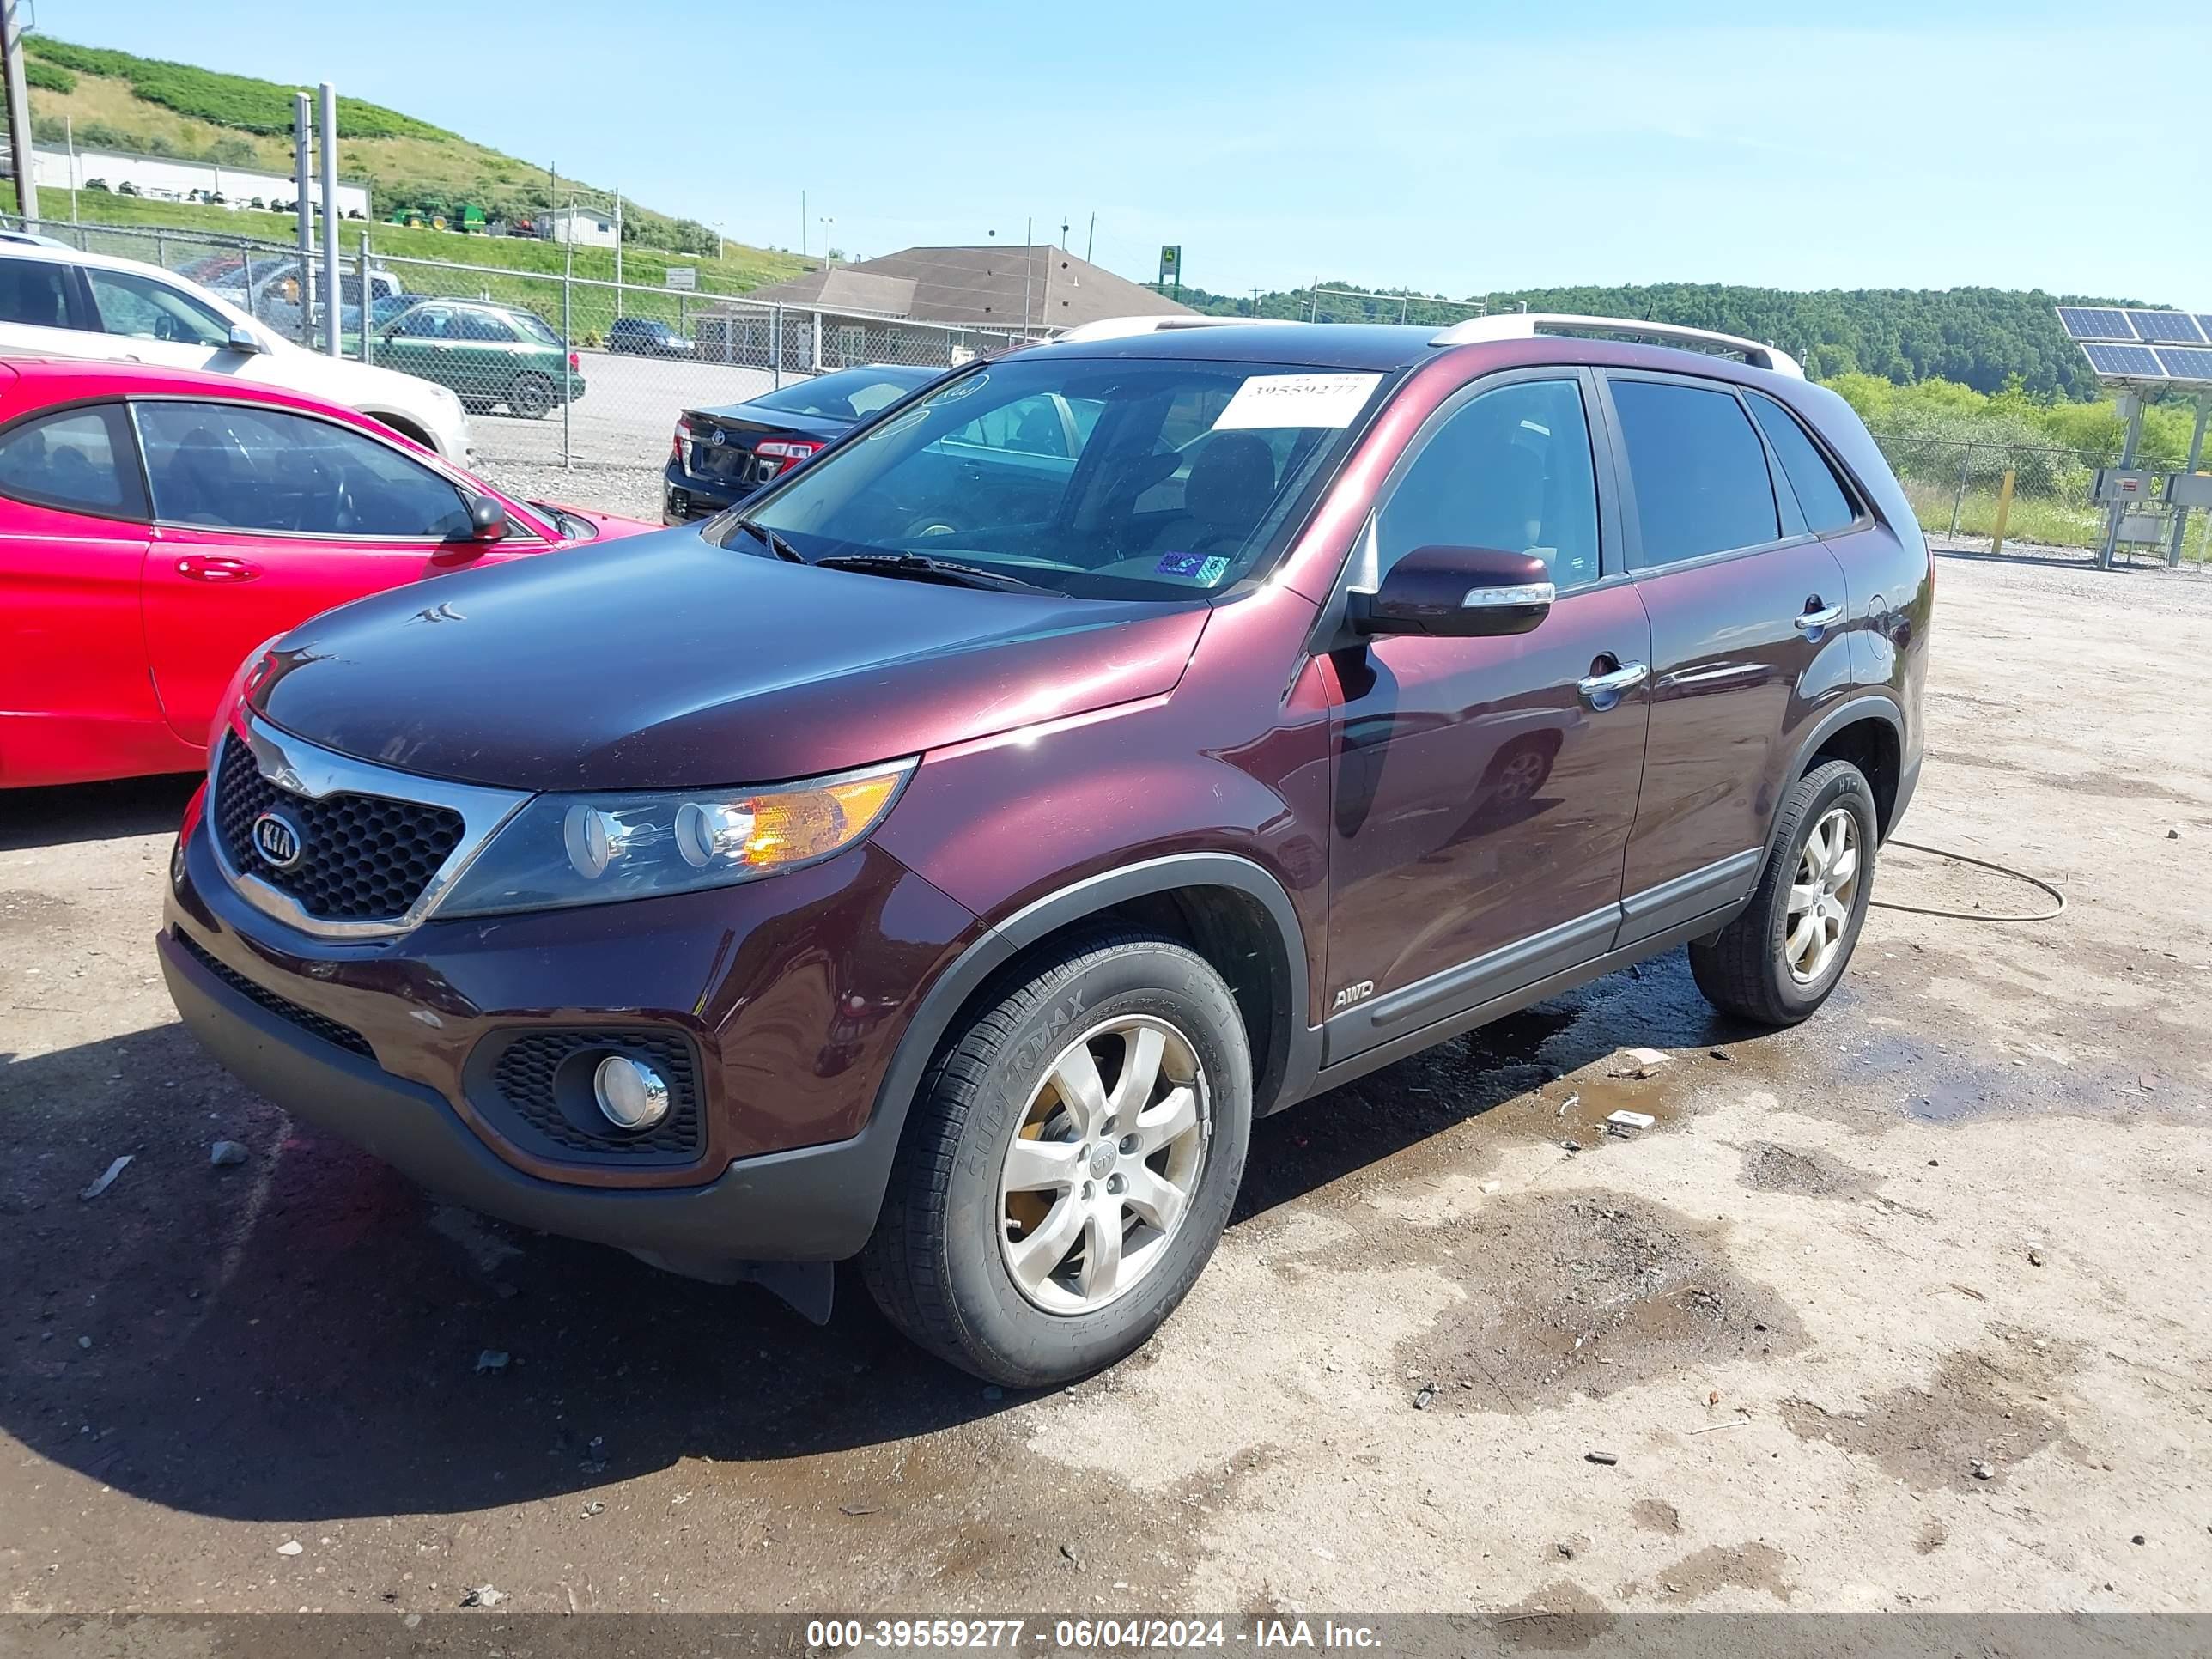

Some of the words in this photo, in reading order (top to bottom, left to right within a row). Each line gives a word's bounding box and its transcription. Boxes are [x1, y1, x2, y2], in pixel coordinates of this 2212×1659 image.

[1250, 384, 1358, 397] 39559277
[1209, 560, 1220, 570] 6
[262, 822, 291, 859] KIA
[1332, 980, 1375, 1011] AWD
